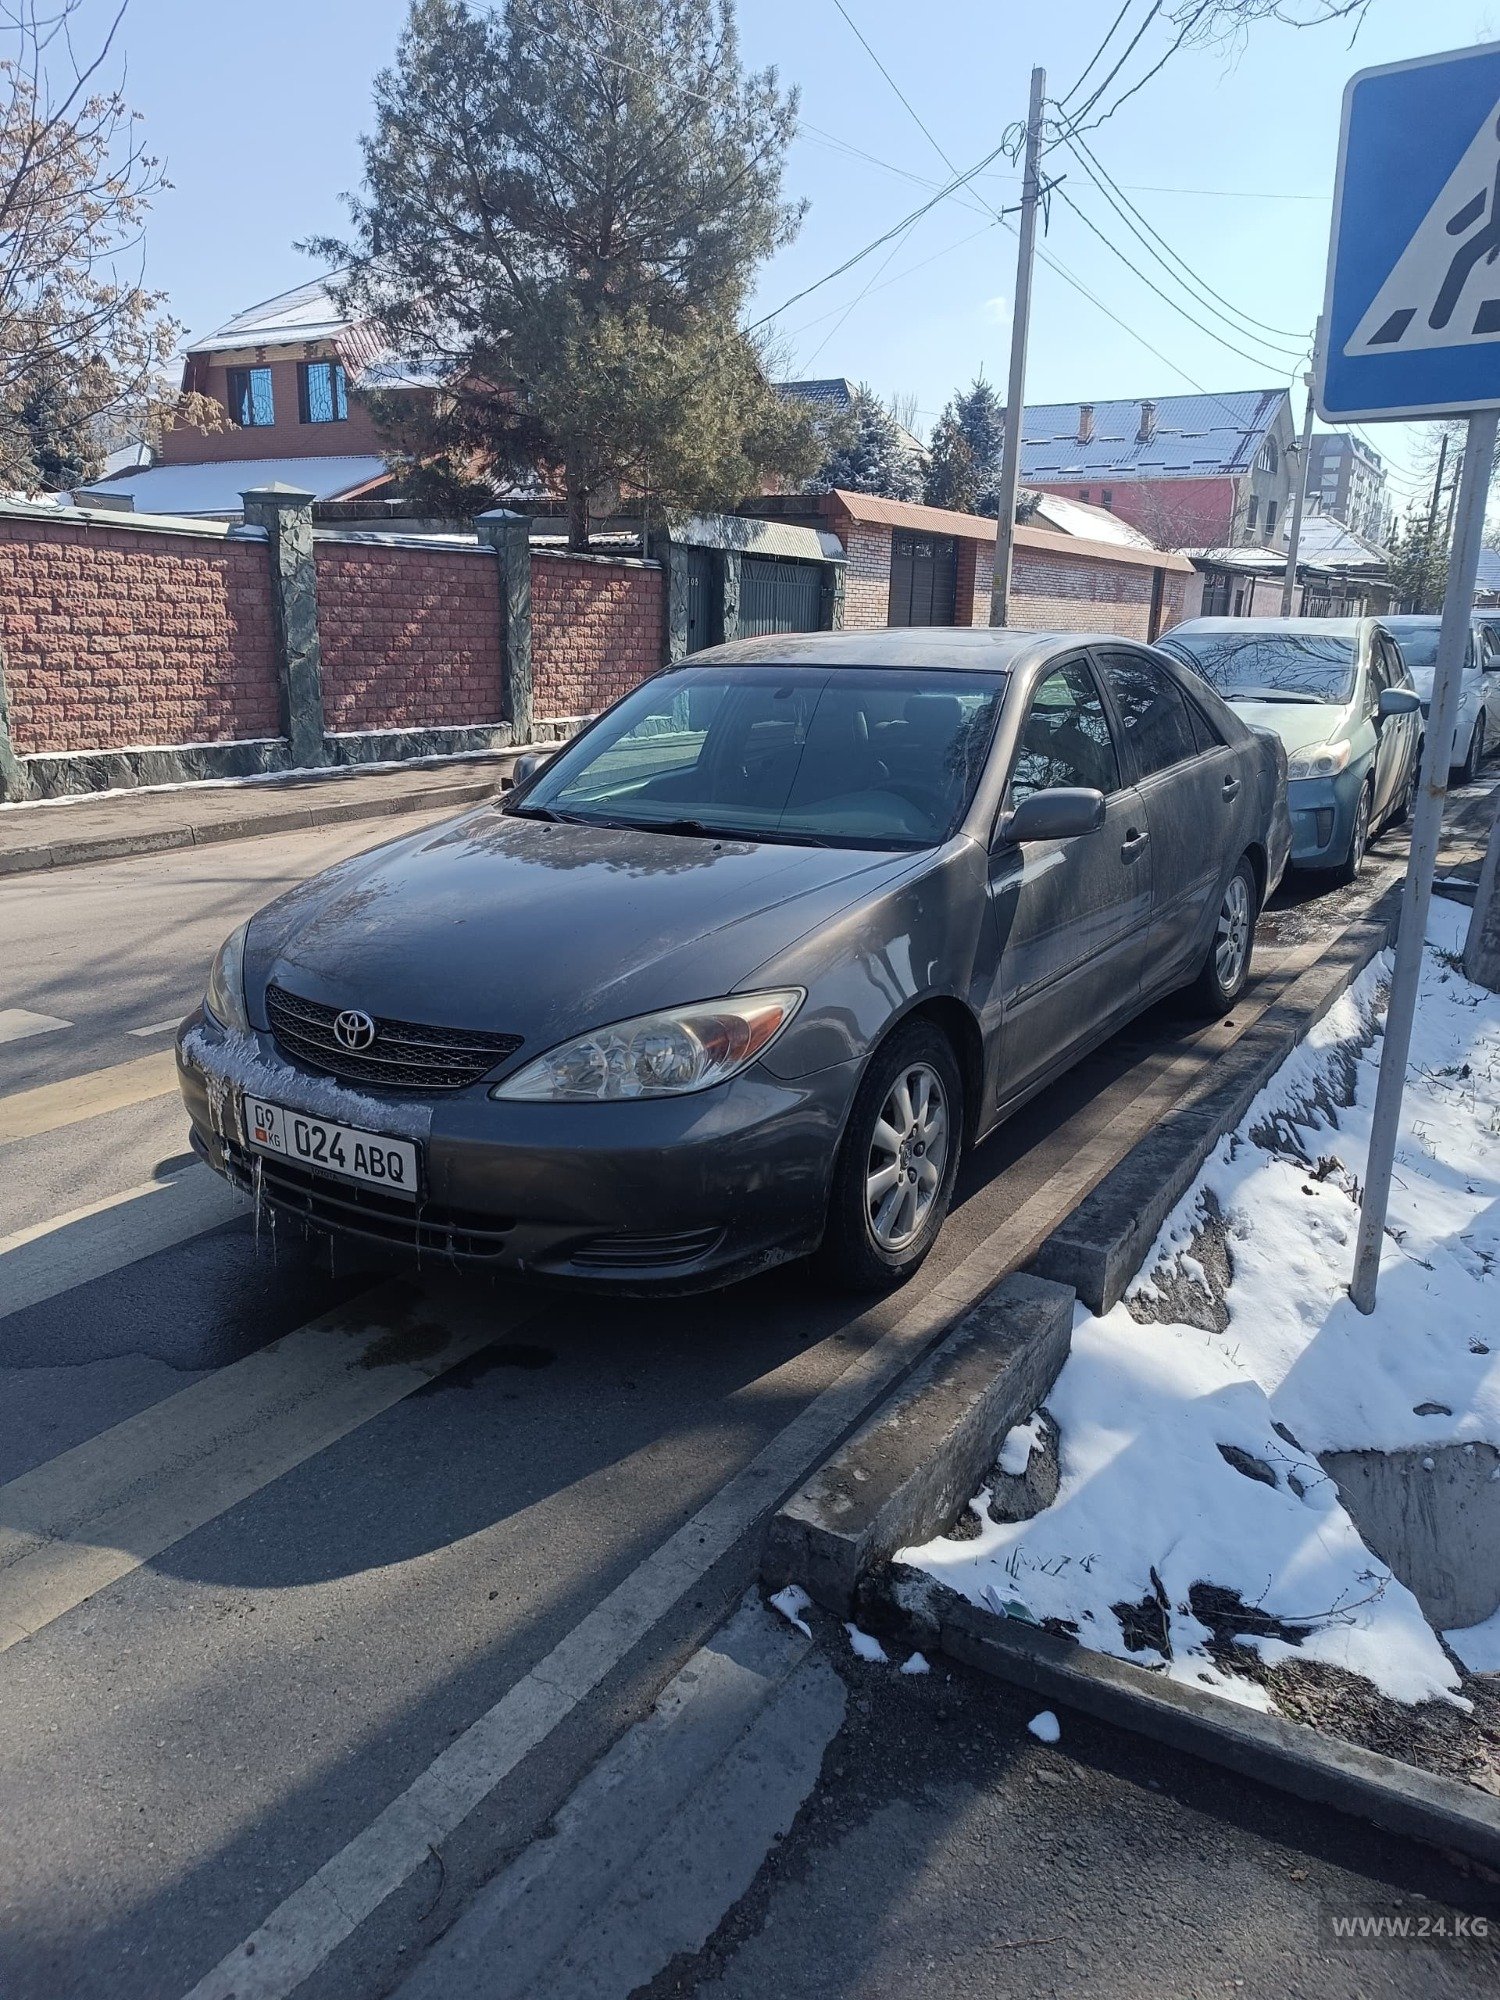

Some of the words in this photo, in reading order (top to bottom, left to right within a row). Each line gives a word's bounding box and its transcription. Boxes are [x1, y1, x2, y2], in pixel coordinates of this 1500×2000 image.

[255, 1104, 275, 1131] 09
[268, 1134, 281, 1148] KG
[294, 1119, 346, 1168] 024
[354, 1143, 405, 1184] ABQ
[312, 1167, 337, 1180] TOYOTA
